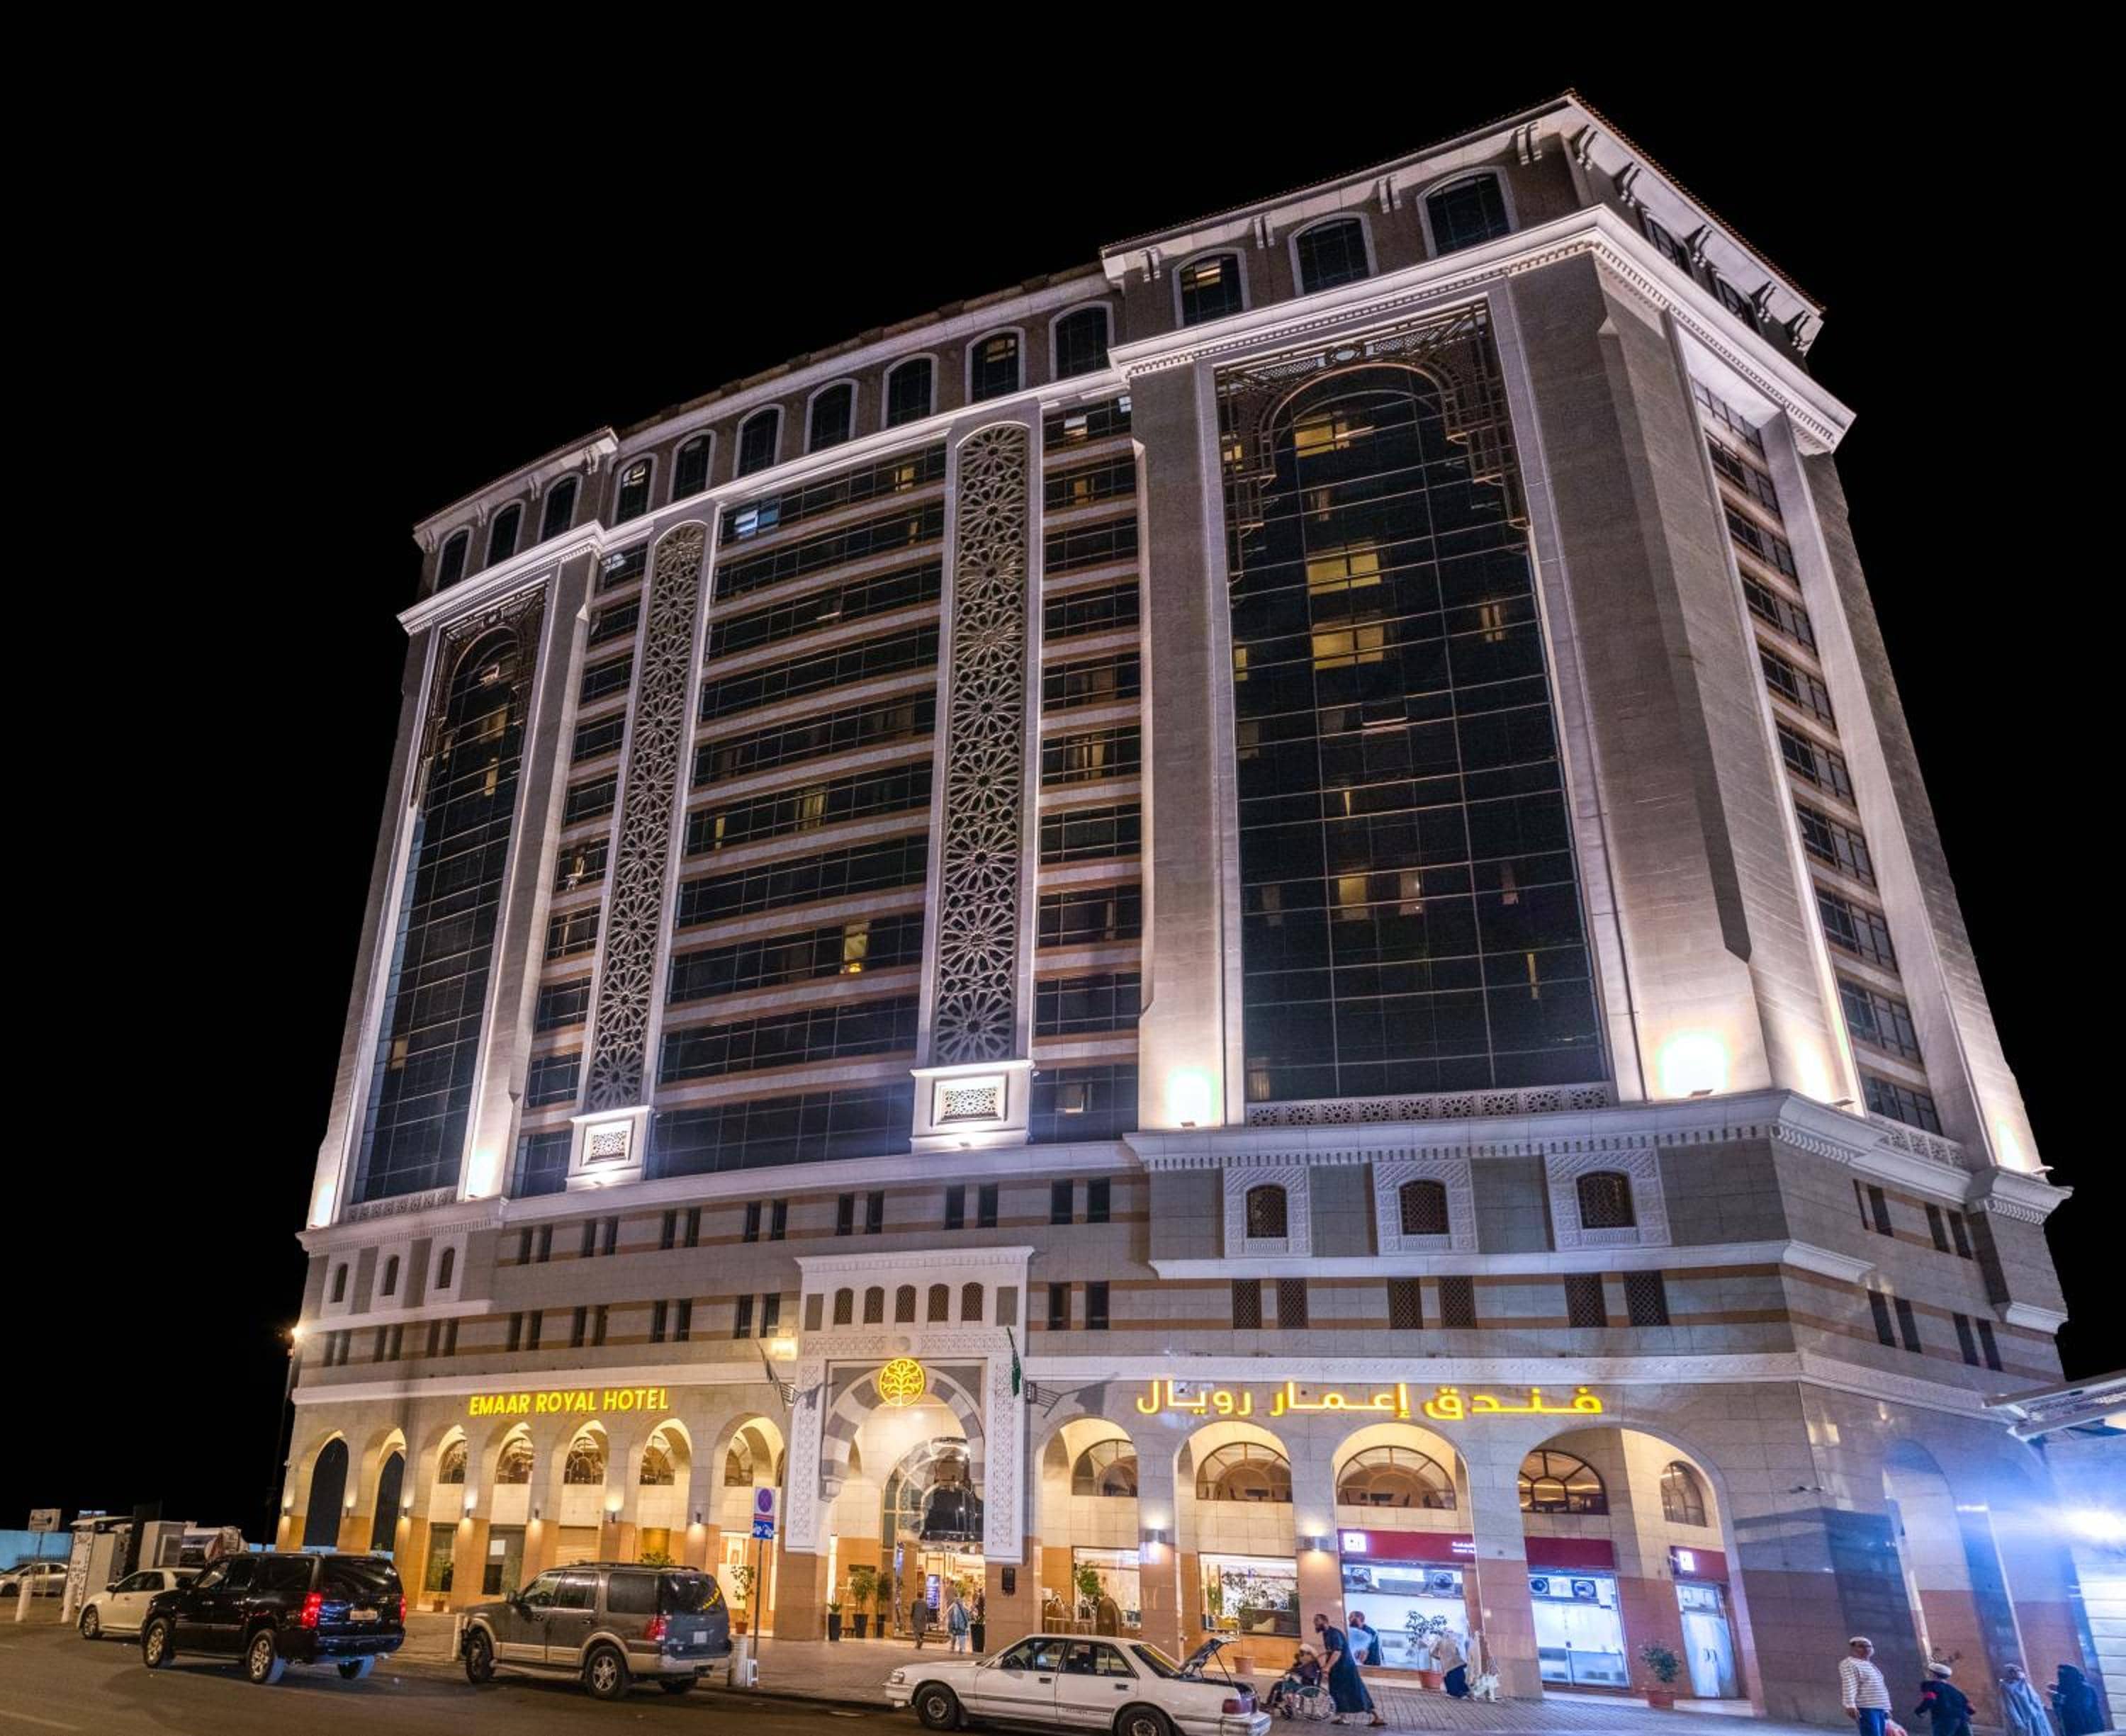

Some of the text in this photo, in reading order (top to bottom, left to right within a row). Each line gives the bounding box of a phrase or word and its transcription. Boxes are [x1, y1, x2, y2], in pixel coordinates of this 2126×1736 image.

[468, 1388, 670, 1416] EMAAR ROYAL HOTEL
[1136, 1380, 1603, 1420] فندق إعمار رويال
